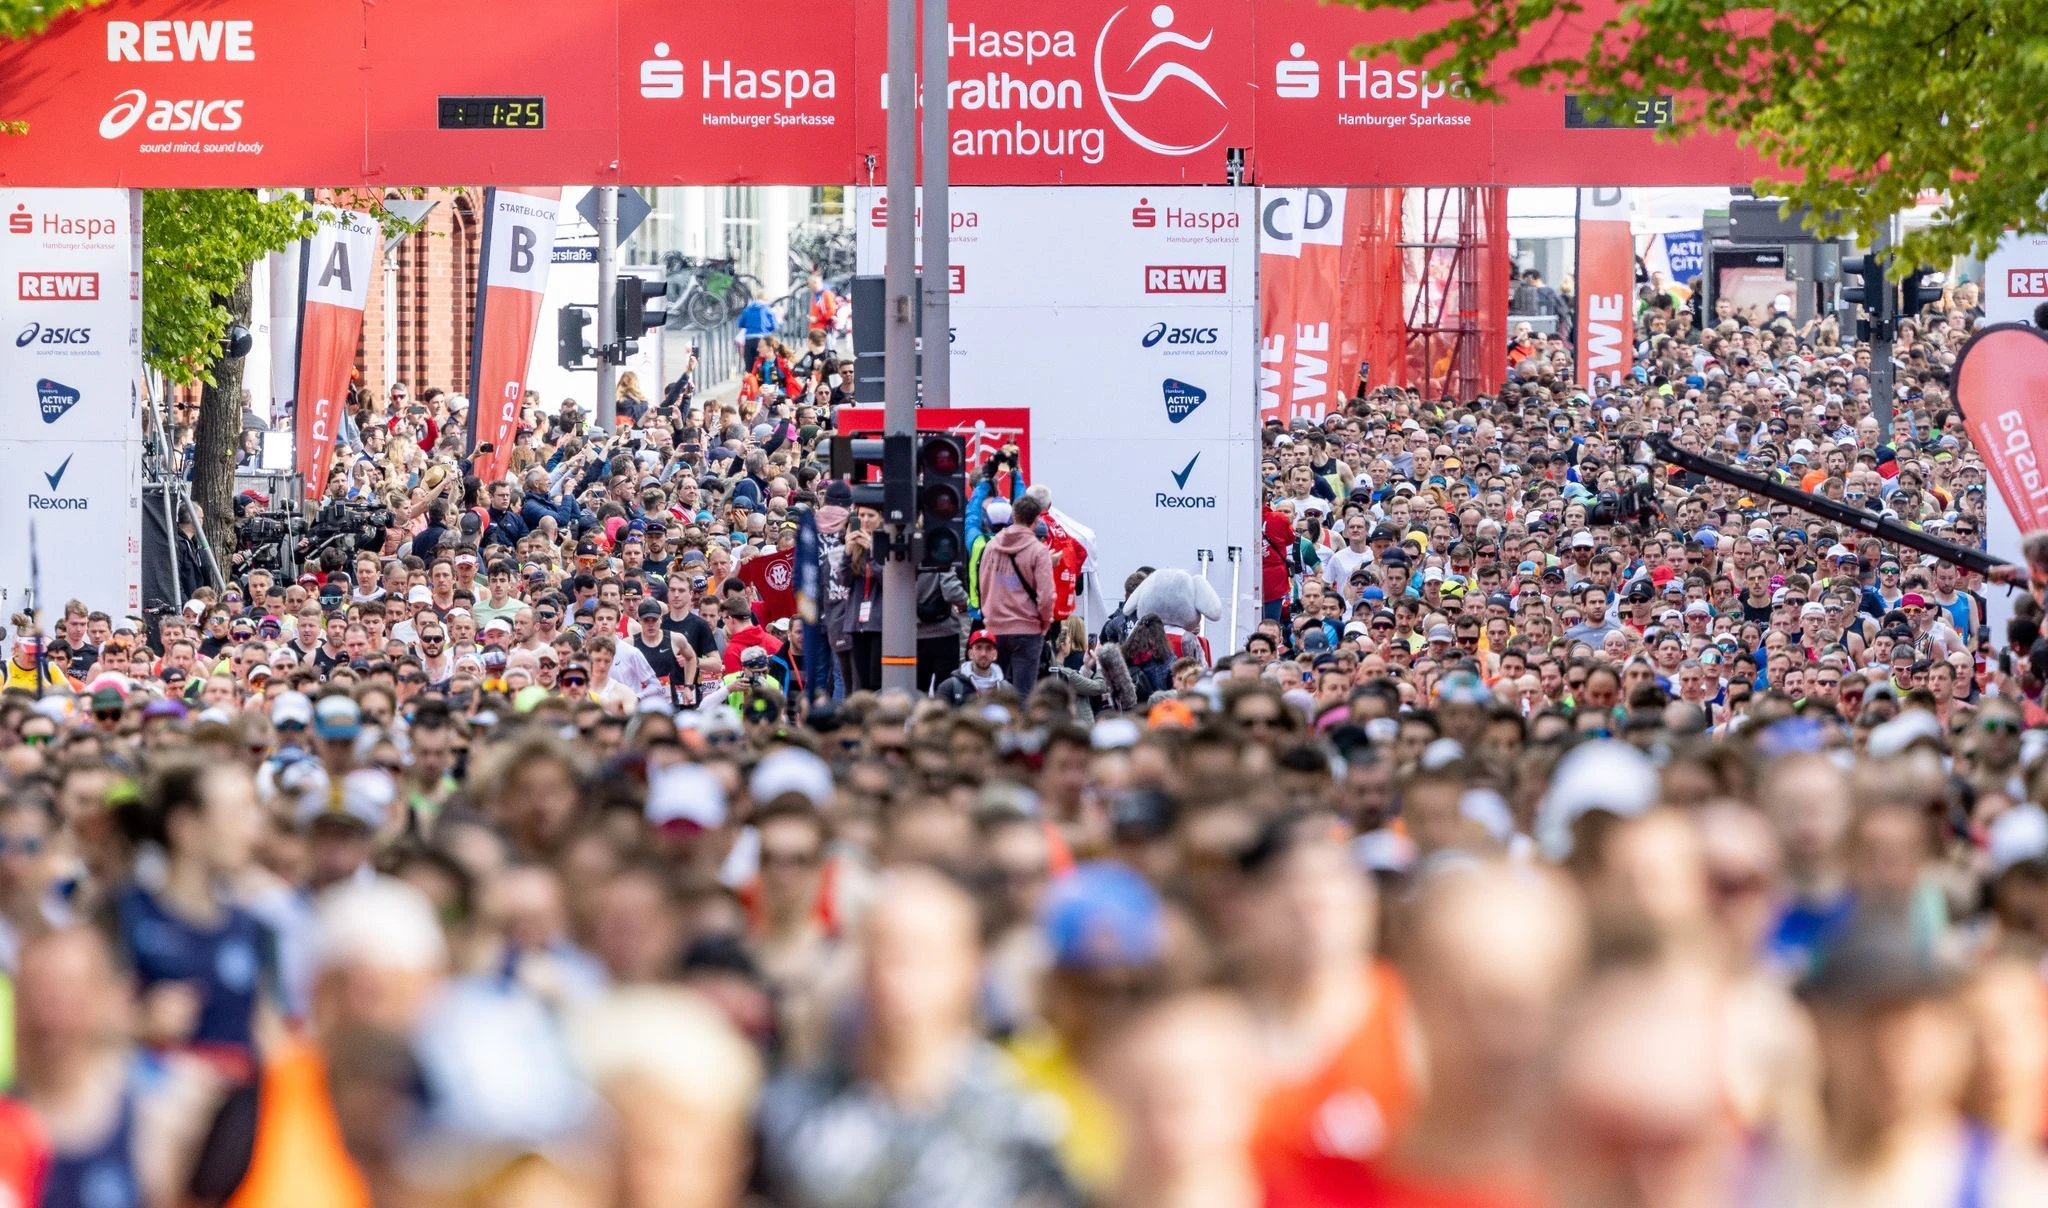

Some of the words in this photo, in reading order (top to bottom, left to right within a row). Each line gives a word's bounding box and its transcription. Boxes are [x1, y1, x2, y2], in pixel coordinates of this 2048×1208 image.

[107, 20, 256, 62] REWE
[947, 22, 1077, 66] Haspa
[702, 59, 836, 109] Haspa
[881, 71, 1083, 110] rathon
[1338, 60, 1471, 109] Haspa
[146, 99, 245, 132] asics
[702, 112, 771, 128] Hamburger
[773, 112, 836, 128] Sparkasse
[1338, 112, 1407, 128] Hamburger
[1409, 112, 1472, 128] Sparkasse
[139, 141, 172, 153] sound
[173, 141, 200, 154] mind,
[203, 141, 235, 153] sound
[237, 141, 264, 156] body
[921, 120, 1105, 165] amburg
[499, 202, 556, 221] STARTBLOCK
[1262, 197, 1293, 241] C
[1303, 188, 1333, 230] D
[43, 213, 116, 240] Haspa
[1166, 207, 1240, 234] Haspa
[42, 242, 80, 250] Hamburger
[81, 242, 116, 250] Sparkasse
[509, 225, 537, 274] B
[1166, 235, 1204, 245] Hamburger
[1205, 235, 1240, 245] Sparkasse
[1669, 242, 1703, 256] ACTI
[551, 248, 593, 261] erstraße
[318, 241, 353, 292] A
[22, 276, 96, 297] REWE
[1148, 269, 1223, 290] REWE
[2011, 272, 2048, 294] RE
[40, 327, 91, 344] asics
[1166, 327, 1218, 344] asics
[41, 395, 74, 405] ACTIVE
[42, 405, 63, 413] CITY
[1167, 395, 1200, 405] ACTIVE
[1168, 405, 1189, 414] CITY
[28, 493, 88, 510] Rexona
[1155, 492, 1217, 508] Rexona
